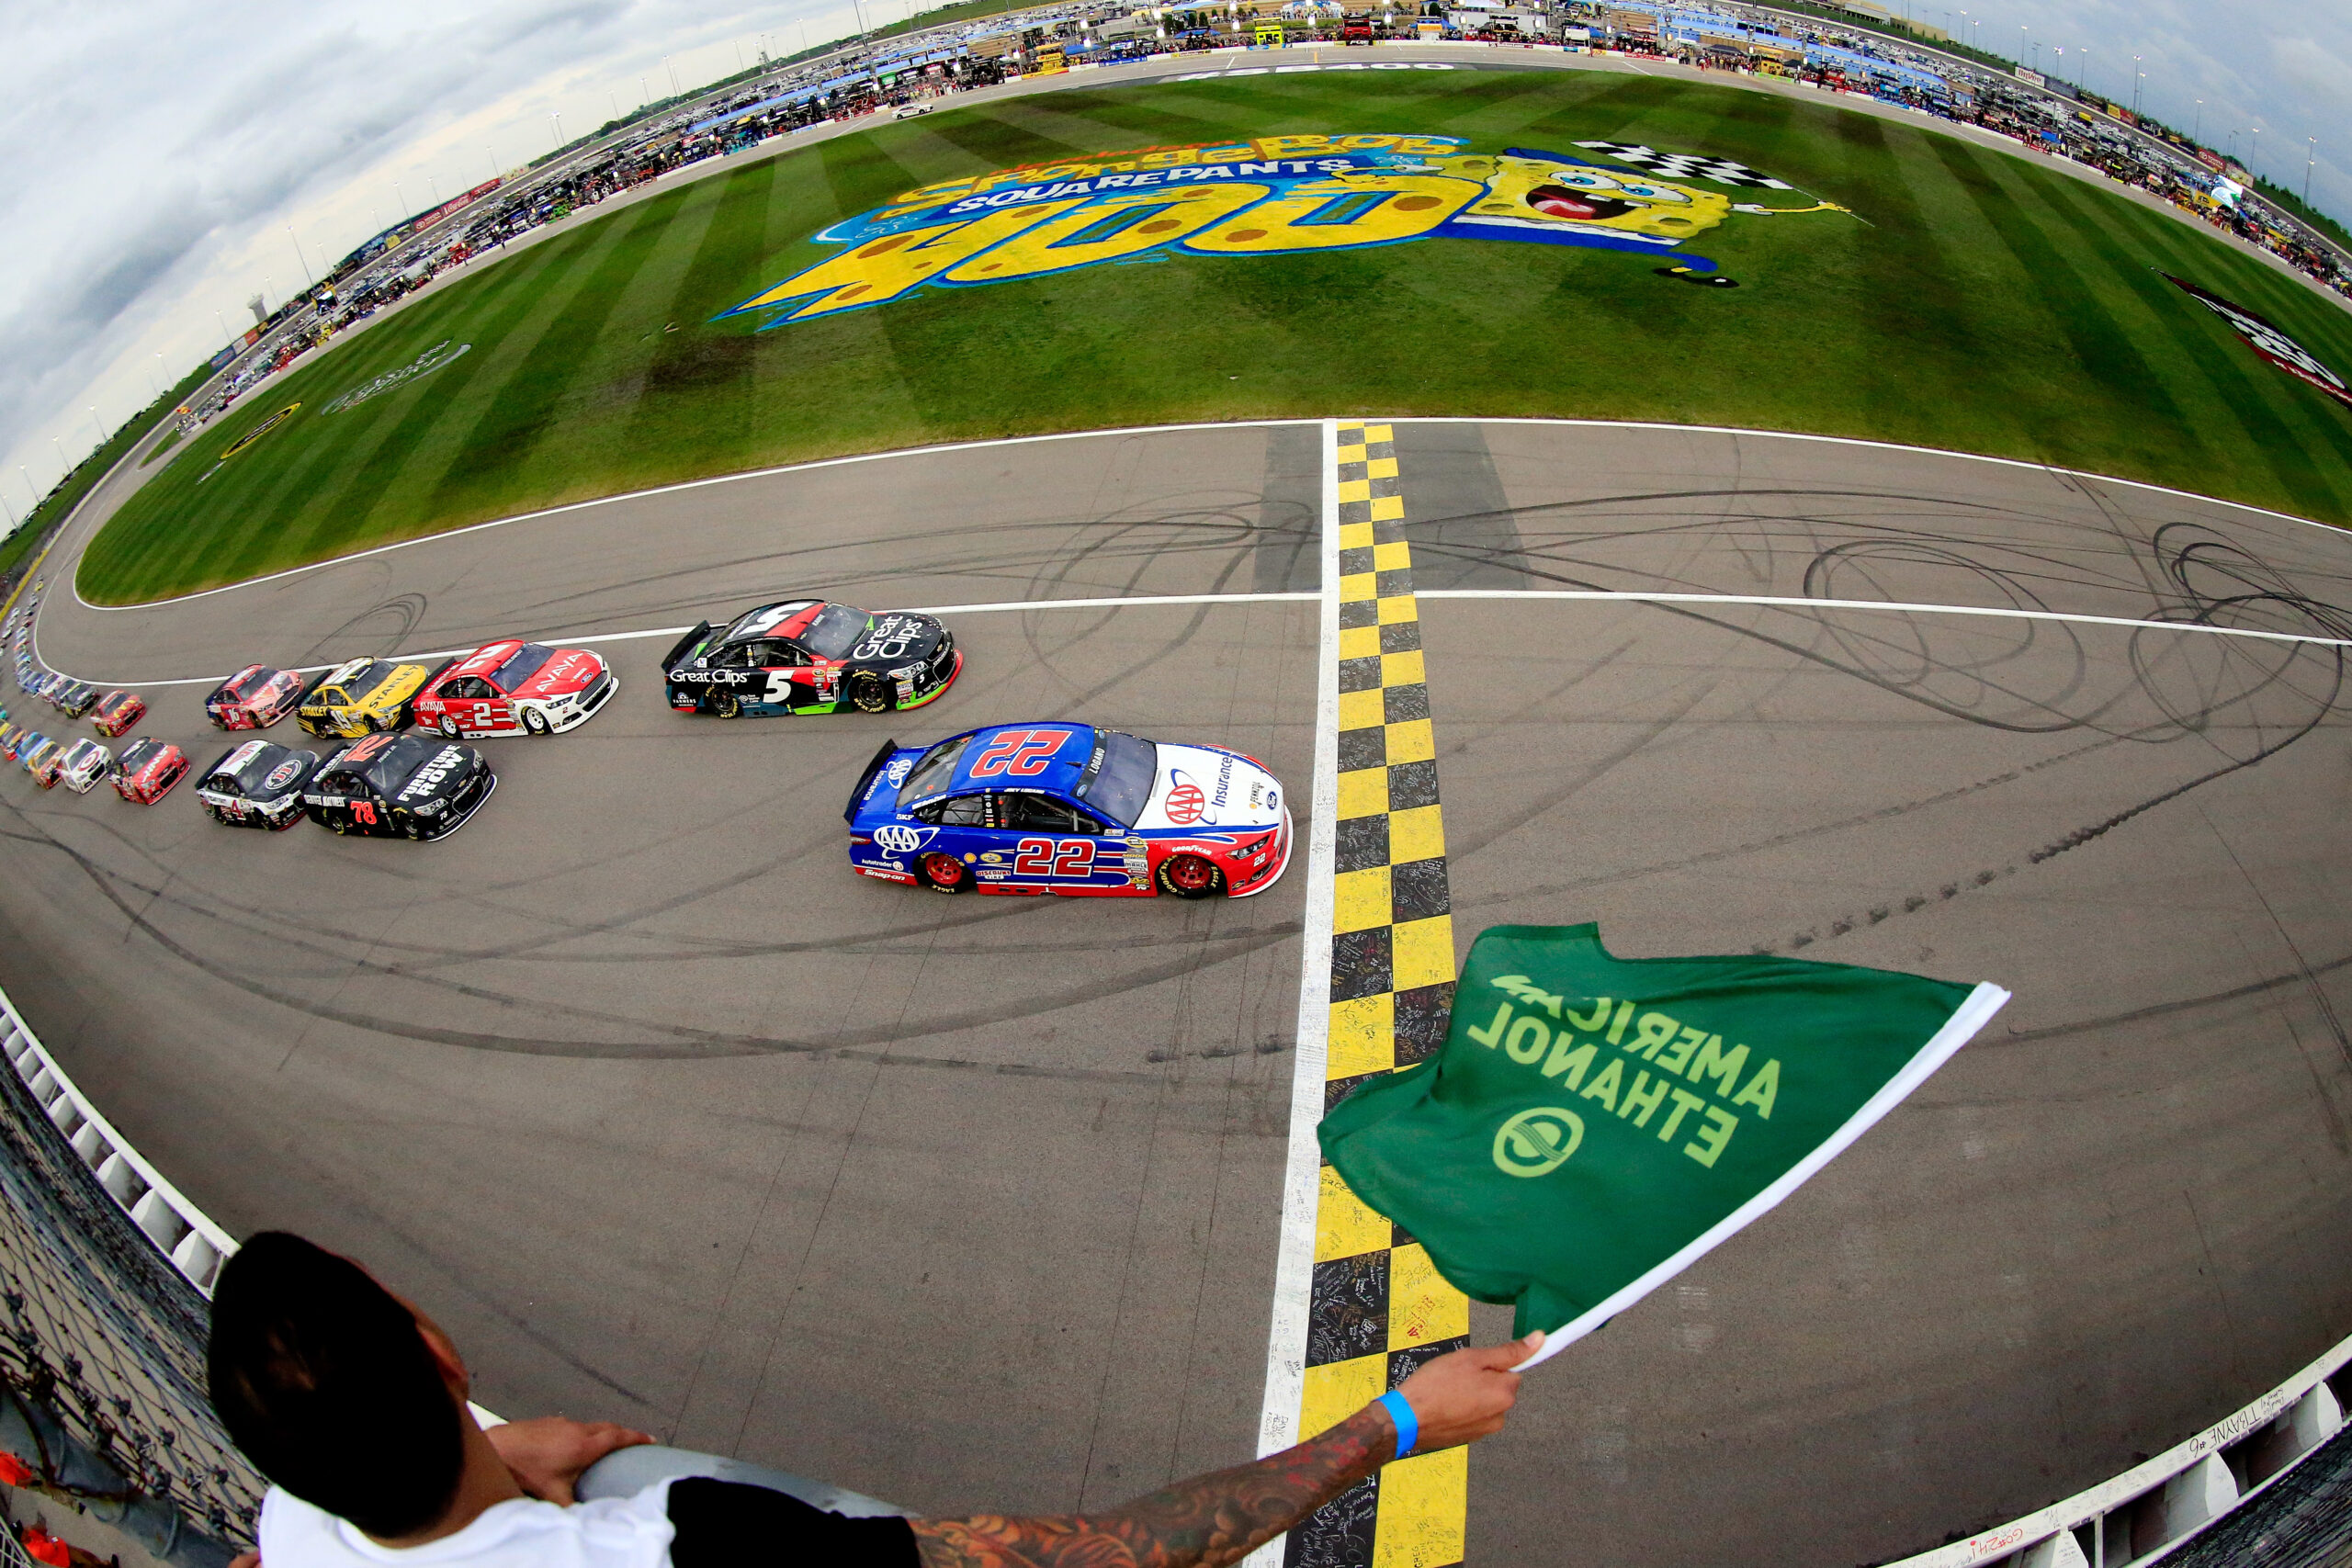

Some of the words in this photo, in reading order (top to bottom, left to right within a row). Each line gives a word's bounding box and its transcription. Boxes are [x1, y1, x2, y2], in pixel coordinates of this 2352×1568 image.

[948, 158, 1356, 215] SQUAREPANTS
[853, 615, 904, 660] Great
[878, 618, 923, 659] Clips
[536, 652, 584, 693] AVAYA
[669, 669, 711, 682] Great
[711, 668, 749, 687] Clips
[368, 664, 420, 709] STANLEY
[763, 669, 796, 704] 5
[300, 705, 328, 717] STANLEY
[330, 709, 354, 730] 19
[419, 701, 447, 716] AVAYA
[473, 702, 494, 727] 2
[969, 729, 1074, 779] 22
[1088, 747, 1105, 774] LOGANO
[397, 744, 461, 803] FURNITURE
[415, 751, 465, 797] ROW
[863, 770, 888, 801] Insurance
[1211, 752, 1236, 808] Insurance
[230, 799, 247, 821] 4
[350, 800, 378, 825] 78
[896, 813, 915, 821] SKF
[877, 825, 917, 852] AAA
[1171, 844, 1213, 856] GOODYEAR
[1013, 837, 1096, 877] 22
[1253, 852, 1267, 867] 22
[864, 869, 906, 882] Snap-on
